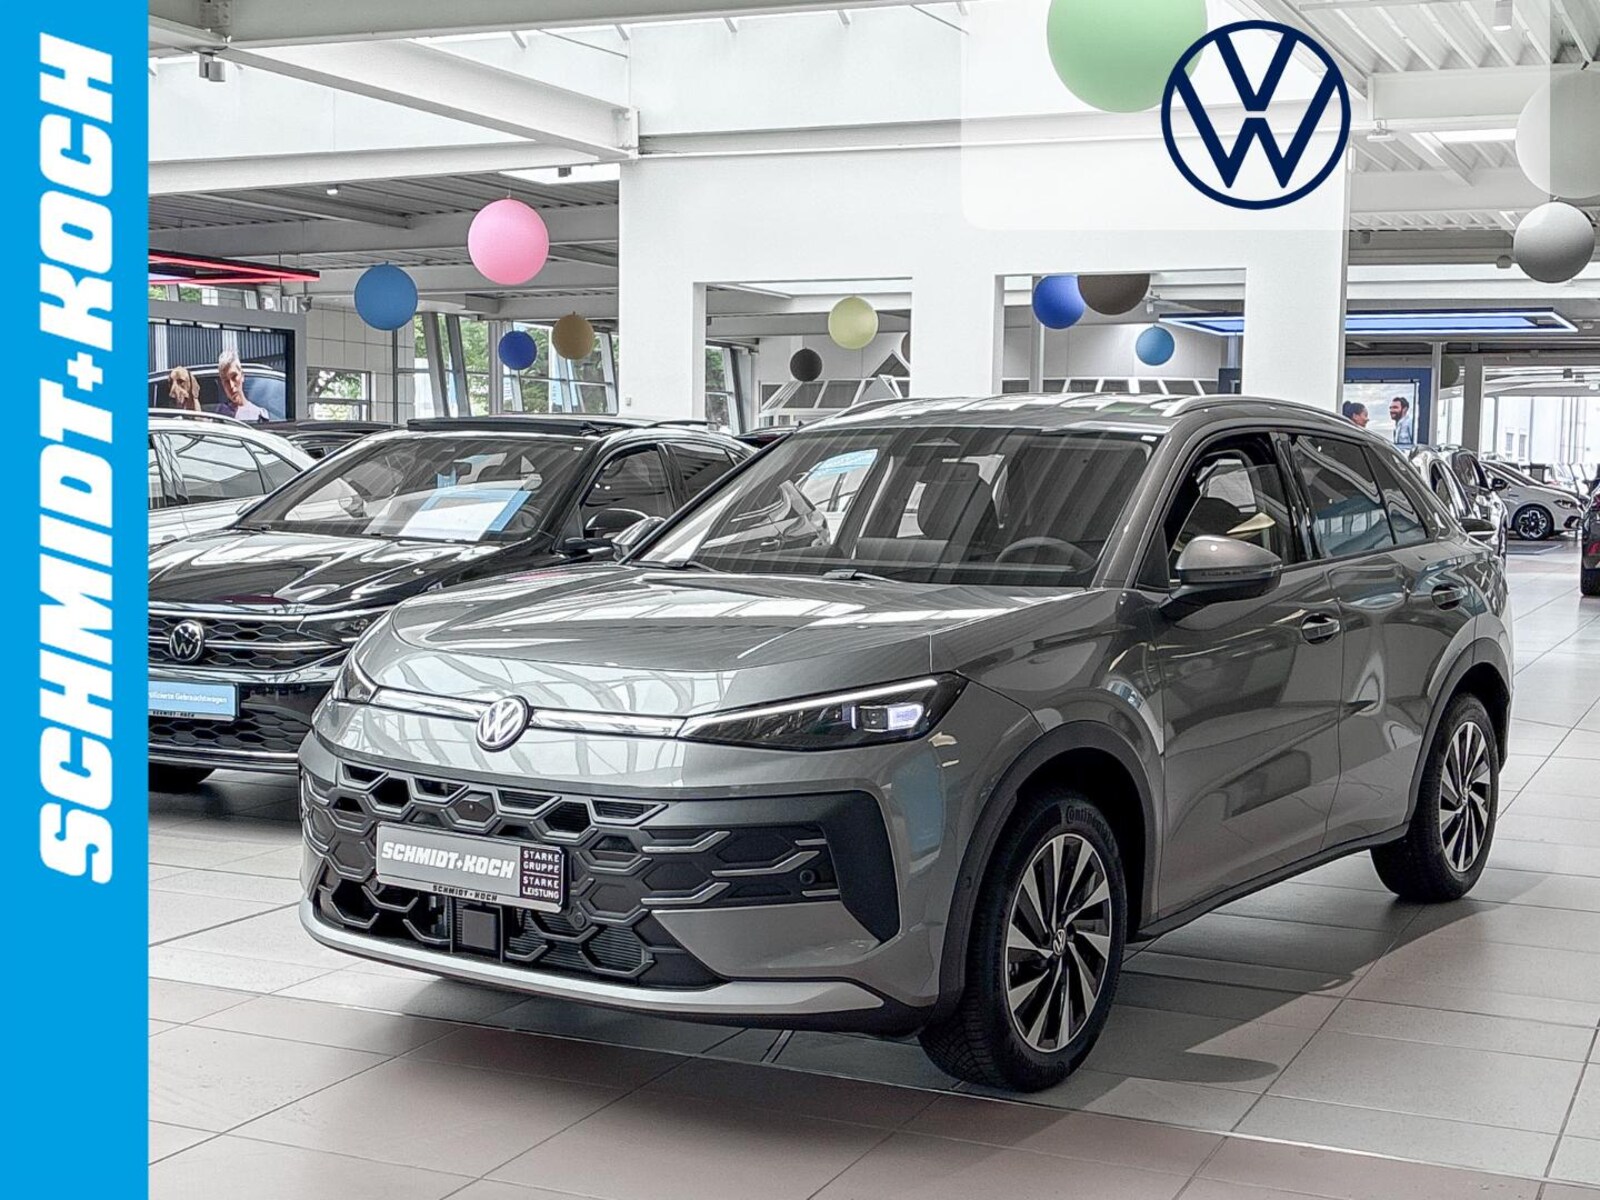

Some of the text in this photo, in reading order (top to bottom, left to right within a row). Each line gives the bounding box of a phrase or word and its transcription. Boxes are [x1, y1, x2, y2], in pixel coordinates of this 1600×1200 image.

[381, 841, 516, 879] SCHMIDT+KOCH
[522, 850, 560, 863] STARKE
[522, 860, 560, 874] GRUPPE
[522, 876, 560, 889] STARKE
[522, 886, 560, 900] LEISTUNG
